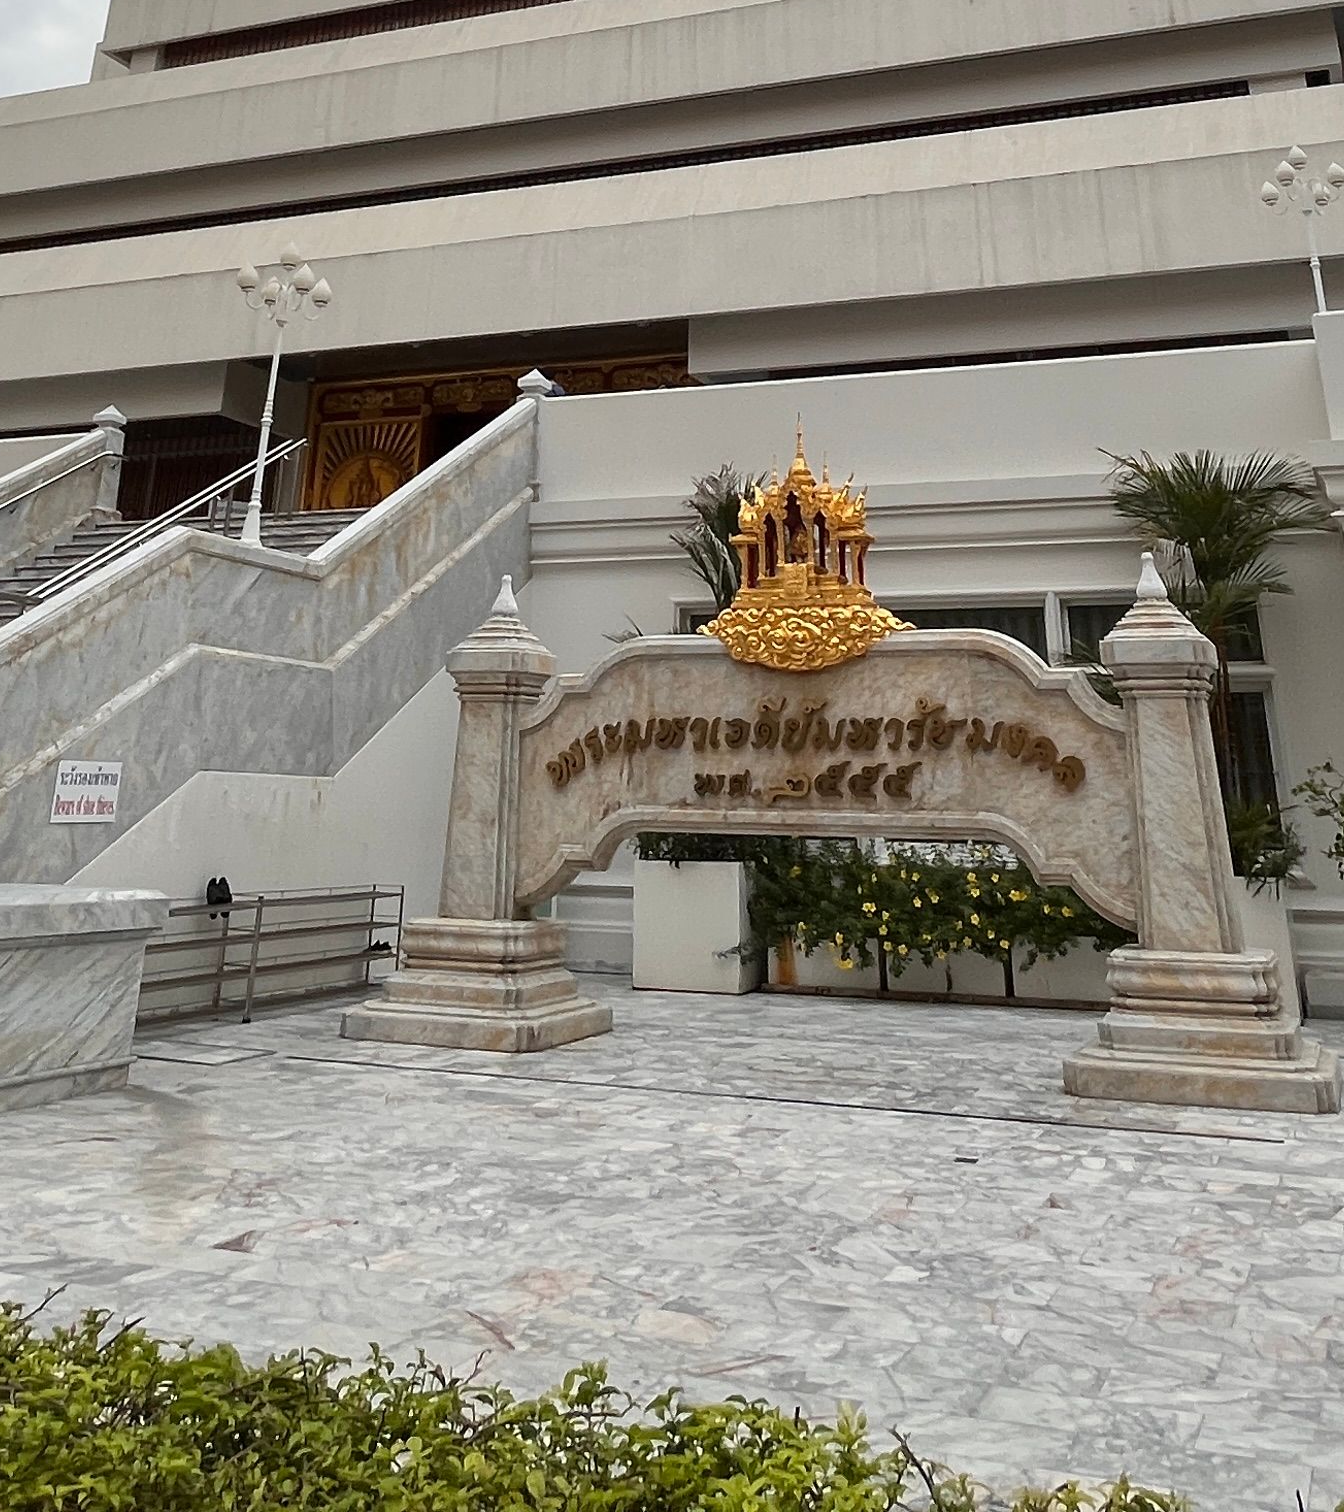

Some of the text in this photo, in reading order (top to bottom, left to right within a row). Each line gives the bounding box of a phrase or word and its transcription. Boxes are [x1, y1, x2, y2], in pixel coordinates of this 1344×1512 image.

[545, 696, 1086, 793] พระมหาเจดีย์มหารัชมงคล
[767, 760, 923, 803] ๒๕๕๕
